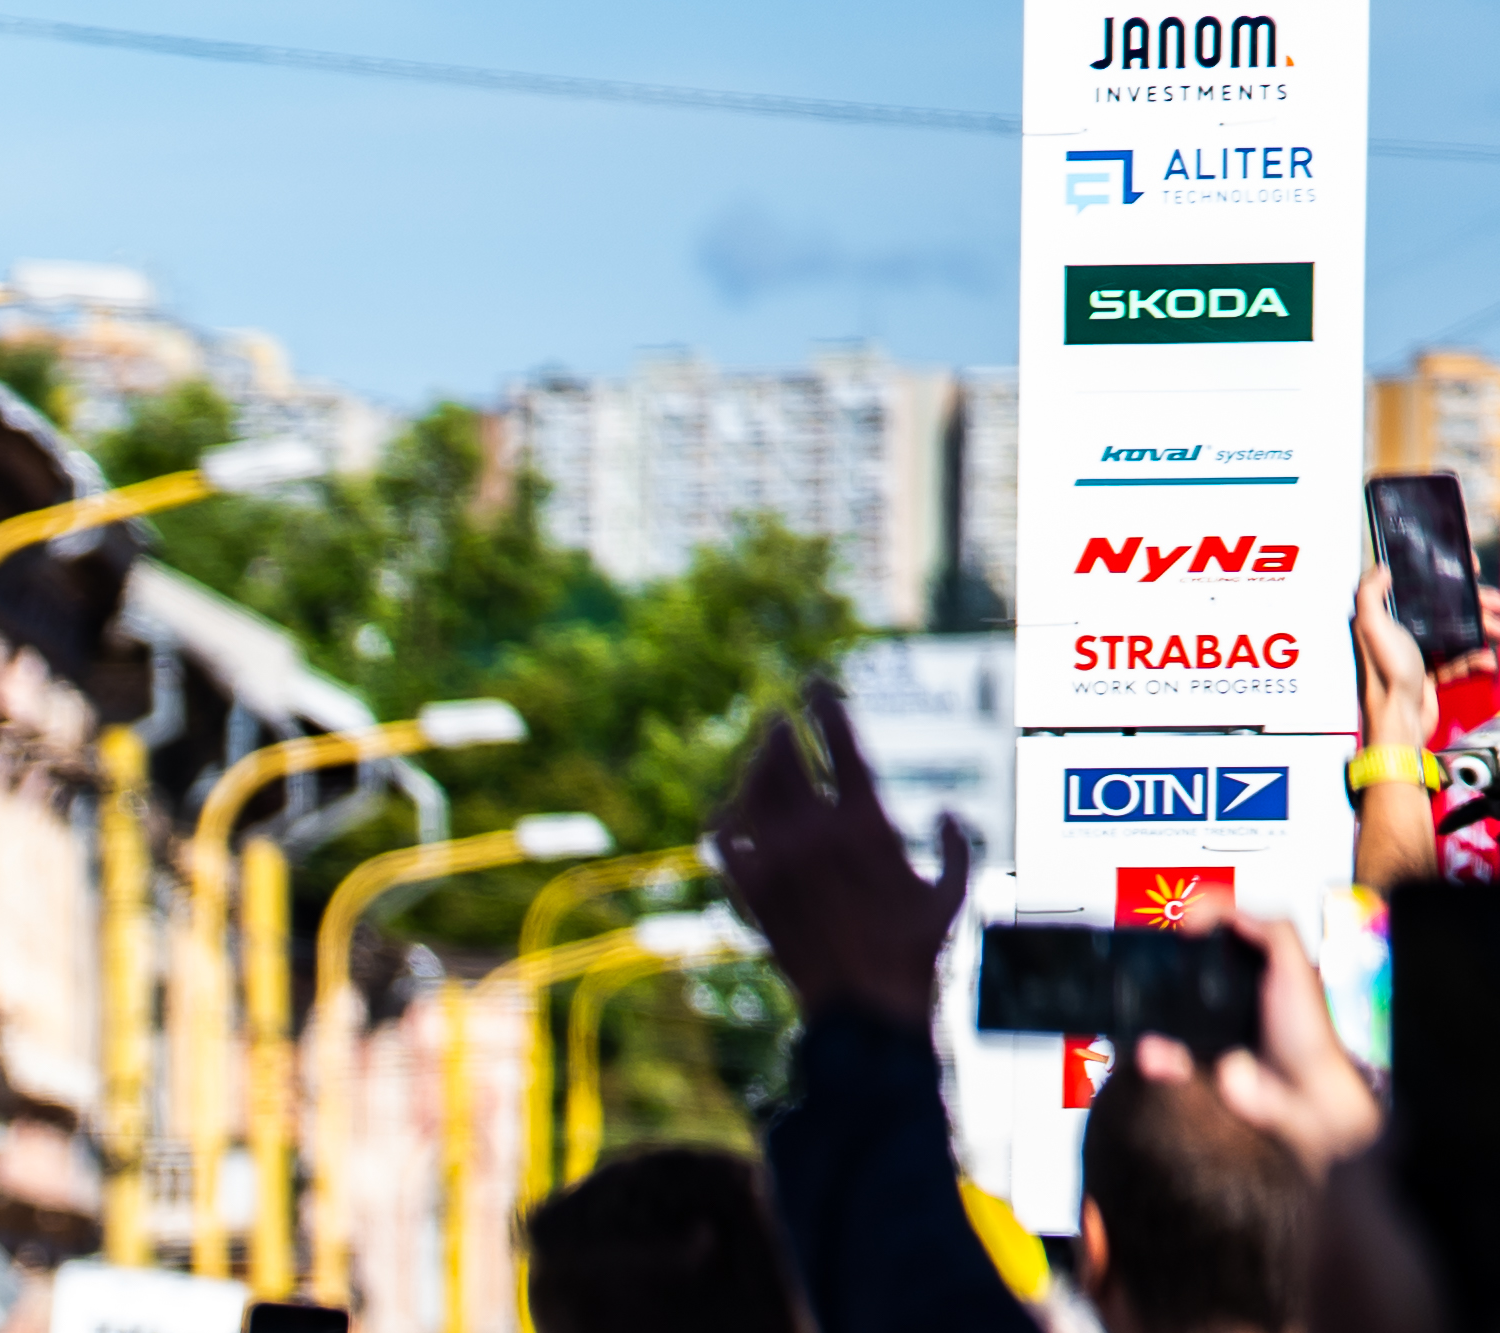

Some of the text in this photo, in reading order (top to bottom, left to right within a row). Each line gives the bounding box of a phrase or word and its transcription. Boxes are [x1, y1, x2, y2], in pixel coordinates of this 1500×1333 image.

[1096, 84, 1288, 103] INVESTMENTS
[1163, 147, 1315, 180] ALITER
[1162, 187, 1316, 205] TECHNOLOGIES
[1100, 444, 1294, 465] koval systems
[1074, 536, 1300, 583] NyNa
[1074, 633, 1300, 671] STRABAG
[1073, 678, 1298, 696] WORK ON PROGRESS
[1069, 774, 1204, 817] LOTN
